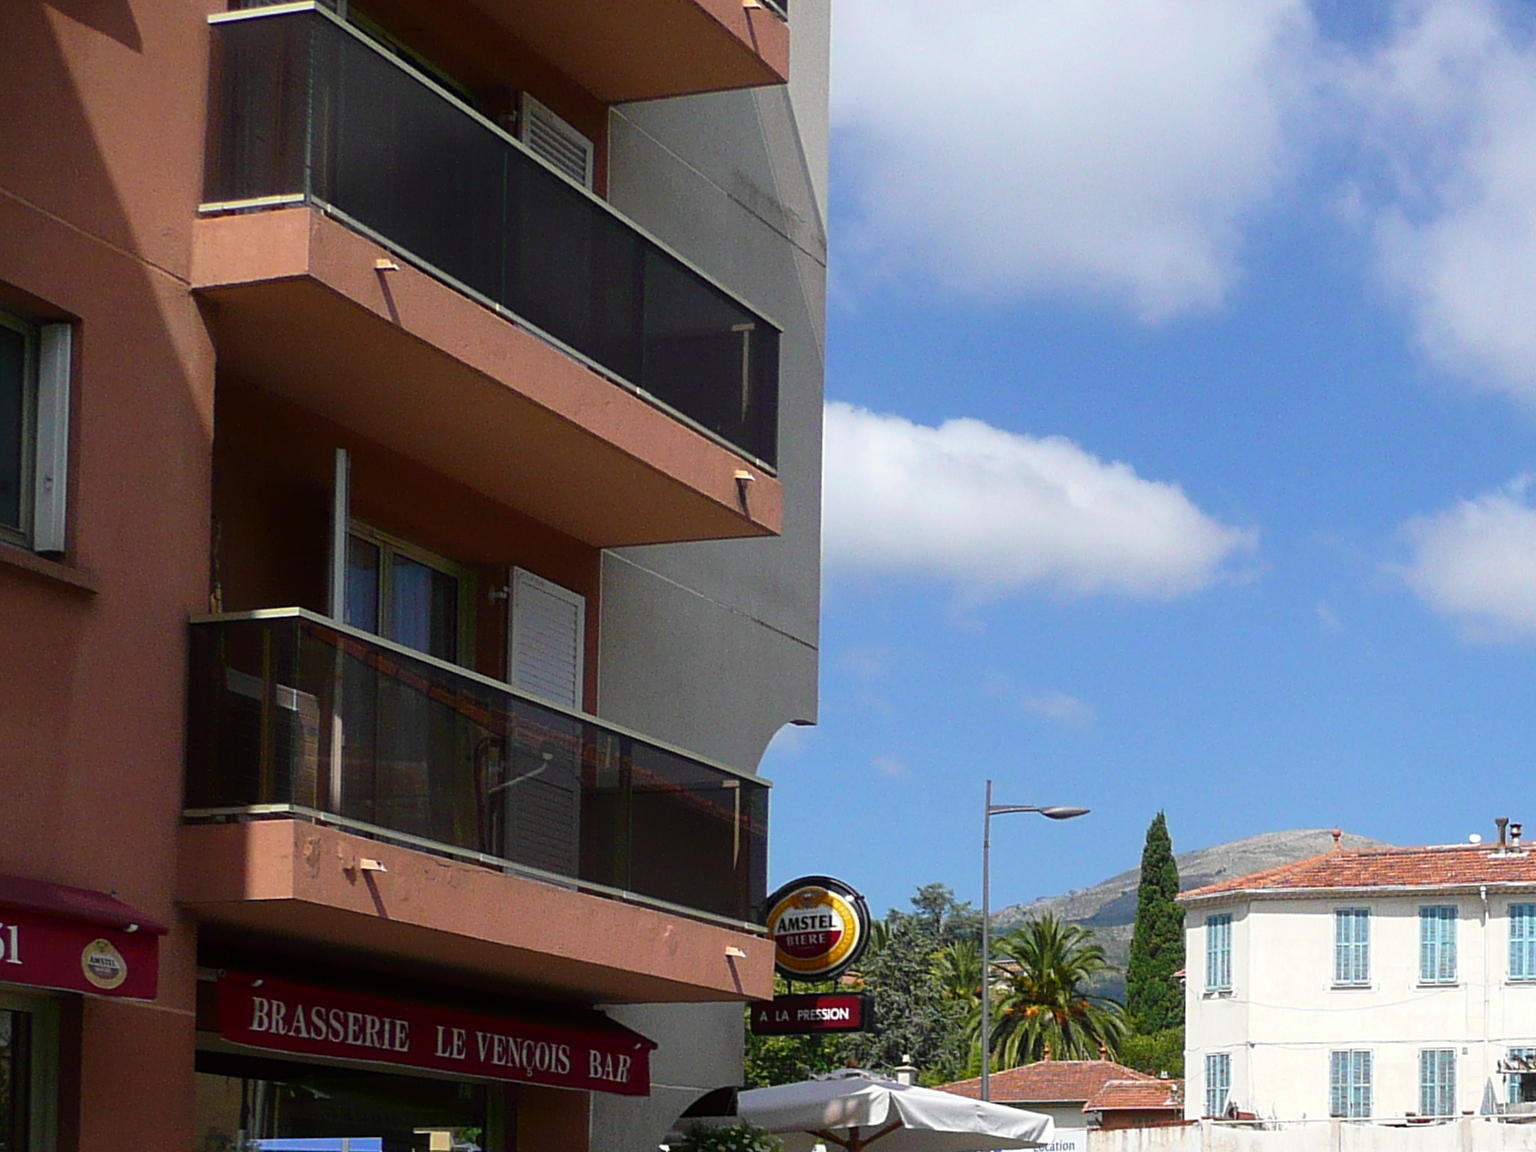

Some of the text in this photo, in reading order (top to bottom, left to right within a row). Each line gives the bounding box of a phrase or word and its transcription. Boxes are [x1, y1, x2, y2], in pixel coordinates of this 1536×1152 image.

[777, 914, 837, 933] AMSTEL
[786, 933, 827, 946] BIERE
[759, 1007, 850, 1022] A LA PRESSION
[248, 996, 632, 1083] BRASSERIE LE VENÇOIS BAR
